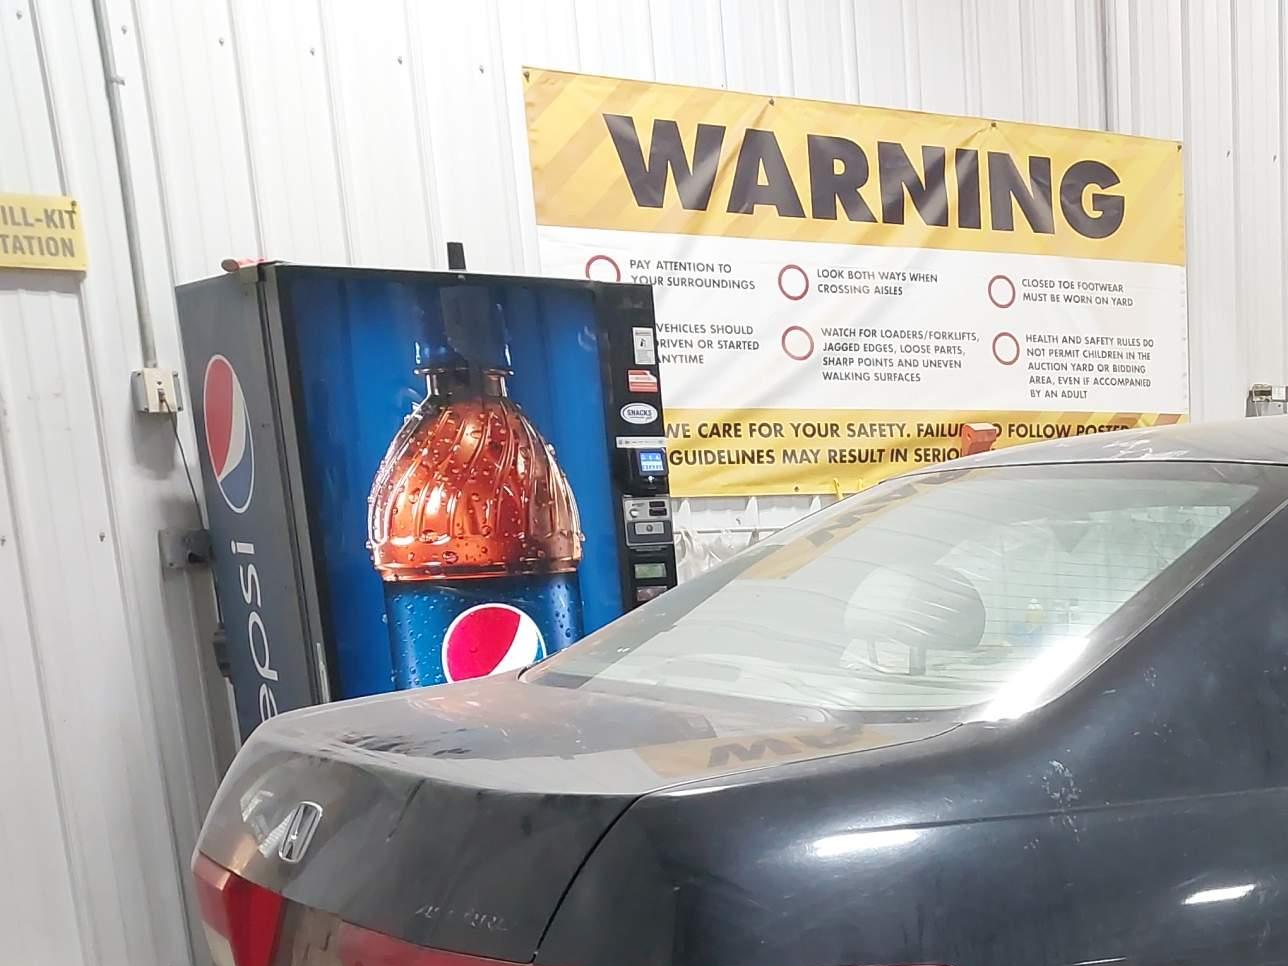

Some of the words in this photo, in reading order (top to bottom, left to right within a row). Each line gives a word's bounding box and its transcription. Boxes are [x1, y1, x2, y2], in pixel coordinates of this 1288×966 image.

[603, 113, 1126, 240] WARNING
[629, 259, 651, 270] PAY
[656, 260, 715, 273] ATTENTION
[718, 263, 732, 274] TO
[631, 275, 664, 287] YOUR
[666, 276, 756, 290] SURROUNDINGS
[817, 269, 844, 279] LOOK
[848, 270, 875, 280] BOTH
[878, 271, 907, 282] WAYS
[909, 272, 938, 283] WHEN
[817, 284, 870, 294] CROSSING
[874, 286, 903, 296] AISLES
[1021, 278, 1055, 289] CLOSED
[1058, 280, 1075, 289] TOE
[1077, 281, 1124, 293] FOOTWEAR
[1022, 293, 1047, 302] MUST
[1050, 294, 1061, 302] BE
[1062, 294, 1094, 305] WORN
[1095, 296, 1109, 305] ON
[1112, 297, 1134, 306] YARD
[655, 323, 706, 334] VEHICLES
[709, 324, 754, 335] SHOULD
[821, 327, 856, 337] WATCH
[859, 328, 877, 338] FOR
[880, 329, 980, 342] LOADERS/FORKLIFTS,
[697, 339, 714, 349] OR
[717, 339, 760, 350] STARTED
[1025, 334, 1058, 344] HEALTH
[1061, 335, 1082, 344] AND
[1084, 336, 1114, 346] SAFETY
[1116, 337, 1141, 347] RULES
[1143, 338, 1154, 348] DO
[822, 343, 860, 352] JAGGED
[863, 344, 896, 354] EDGES,
[900, 345, 931, 354] LOOSE
[934, 345, 966, 356] PARTS,
[1026, 348, 1045, 357] NOT
[1049, 348, 1080, 358] PERMIT
[1082, 349, 1123, 360] CHILDREN
[1125, 351, 1135, 360] IN
[1137, 351, 1151, 360] THE
[822, 357, 854, 366] SHARP
[857, 358, 894, 367] POINTS
[897, 359, 919, 367] AND
[922, 359, 962, 368] UNEVEN
[1027, 362, 1068, 371] AUCTION
[1071, 362, 1094, 372] YARD
[1097, 363, 1110, 372] OR
[1112, 364, 1146, 374] BIDDING
[822, 372, 870, 381] WALKING
[873, 372, 921, 382] SURFACES
[1029, 375, 1055, 385] AREA,
[1057, 376, 1080, 385] EVEN
[1083, 377, 1091, 385] IF
[1093, 377, 1151, 387] ACCOMPANIED
[1030, 389, 1041, 398] BY
[1044, 389, 1058, 398] AN
[1061, 390, 1088, 399] ADULT
[665, 423, 691, 438] WE
[697, 423, 742, 438] CARE
[749, 423, 784, 438] FOR
[790, 423, 841, 438] YOUR
[846, 423, 912, 438] SAFETY.
[1008, 423, 1071, 438] FOLLOW
[669, 449, 775, 465] GUIDELINES
[782, 448, 821, 464] MAY
[828, 448, 886, 464] RESULT
[889, 448, 908, 463] IN
[914, 447, 963, 463] SERIO
